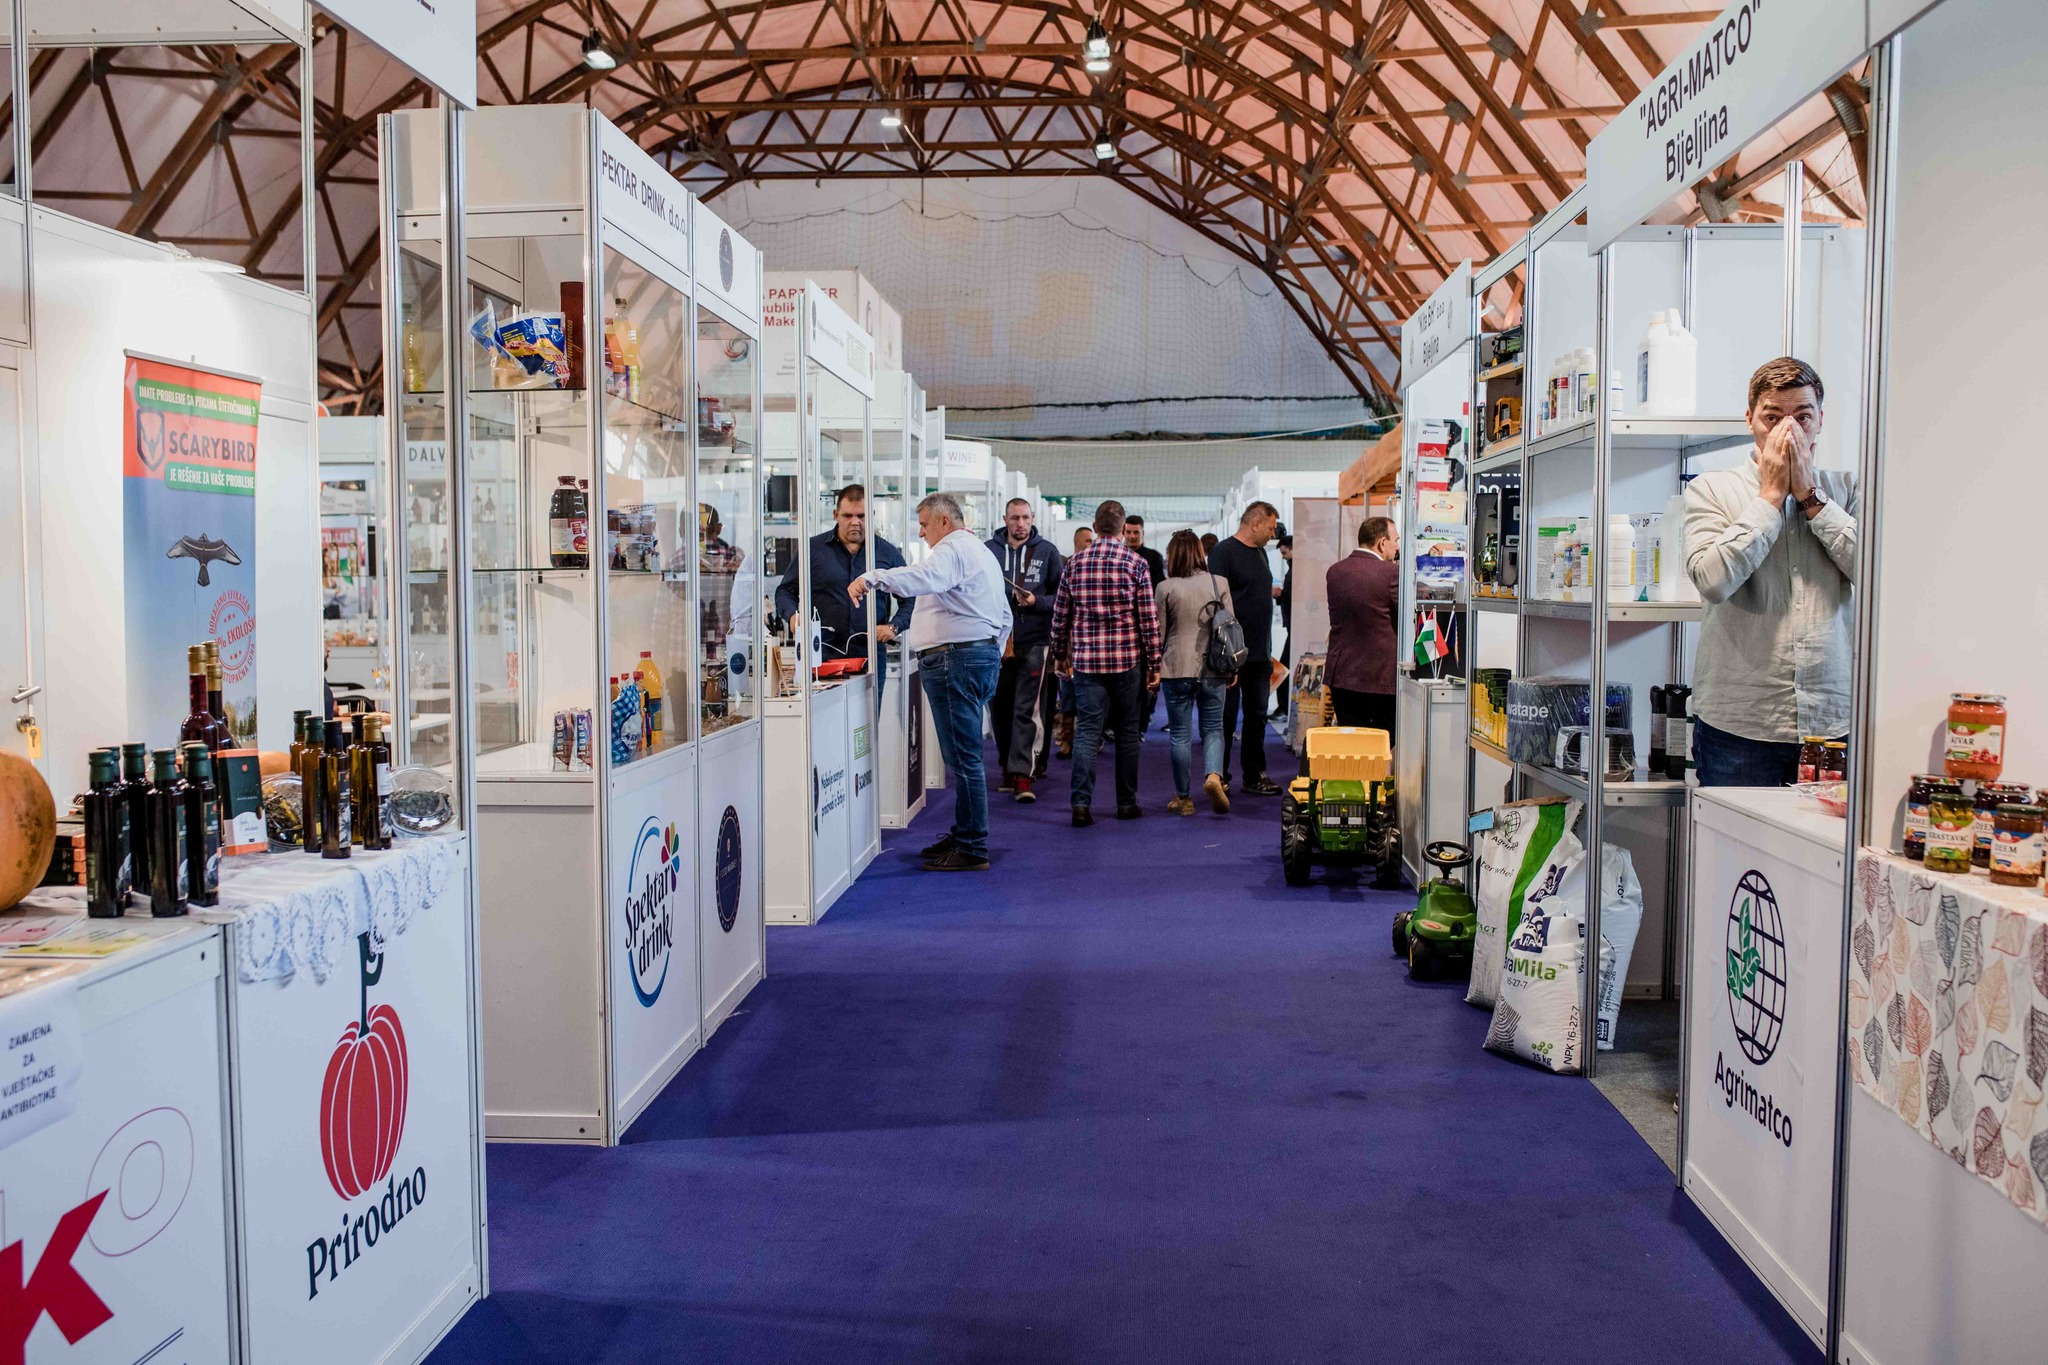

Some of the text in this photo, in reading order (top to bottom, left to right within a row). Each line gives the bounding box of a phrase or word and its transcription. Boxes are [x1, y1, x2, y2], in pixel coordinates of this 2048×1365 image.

[1640, 0, 1761, 138] "AGRI-MATCO"
[1666, 105, 1728, 183] Bijeljina
[602, 150, 638, 200] PEKTAR
[641, 180, 666, 221] DRINK
[139, 385, 156, 400] IMATE
[156, 388, 186, 405] PROBLEME
[186, 394, 195, 406] SA
[169, 430, 255, 463] SCARYBIRD
[170, 466, 255, 488] JE REŠENJE ZA VAŠE PROBLEME
[222, 667, 249, 684] STUPAČNA
[625, 864, 670, 949] Spektar
[639, 904, 672, 977] drink
[9, 1023, 52, 1050] ZAMJENA
[1564, 1005, 1580, 1065] NPK 16-27-7
[23, 1052, 36, 1067] ZA
[1532, 1053, 1552, 1066] 25 kg
[0, 1086, 58, 1121] ANTIBIOTIKE
[1715, 1050, 1792, 1147] Agrimatco
[306, 1166, 426, 1301] Prirodno
